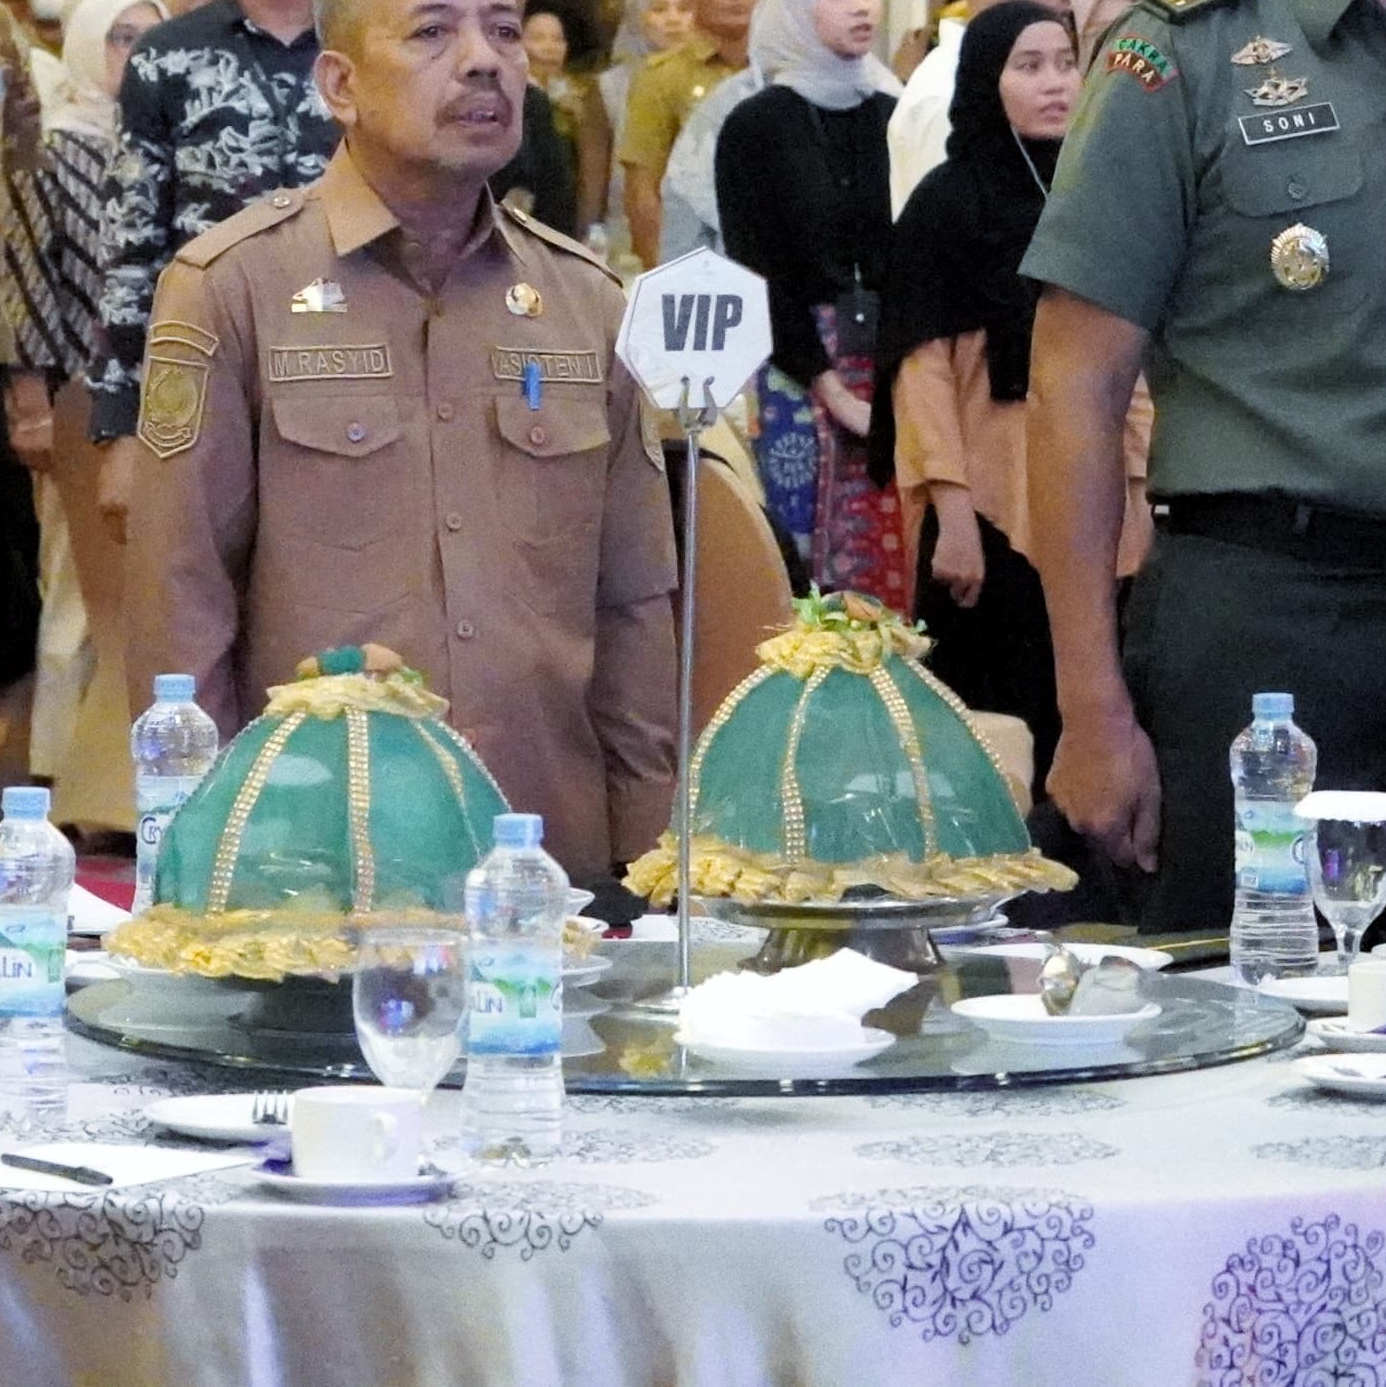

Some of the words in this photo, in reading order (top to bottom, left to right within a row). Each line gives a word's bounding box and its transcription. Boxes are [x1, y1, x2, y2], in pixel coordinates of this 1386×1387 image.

[1113, 53, 1155, 83] PARA
[1263, 112, 1315, 132] SONI
[661, 294, 743, 351] VIP
[298, 350, 386, 375] RASYID
